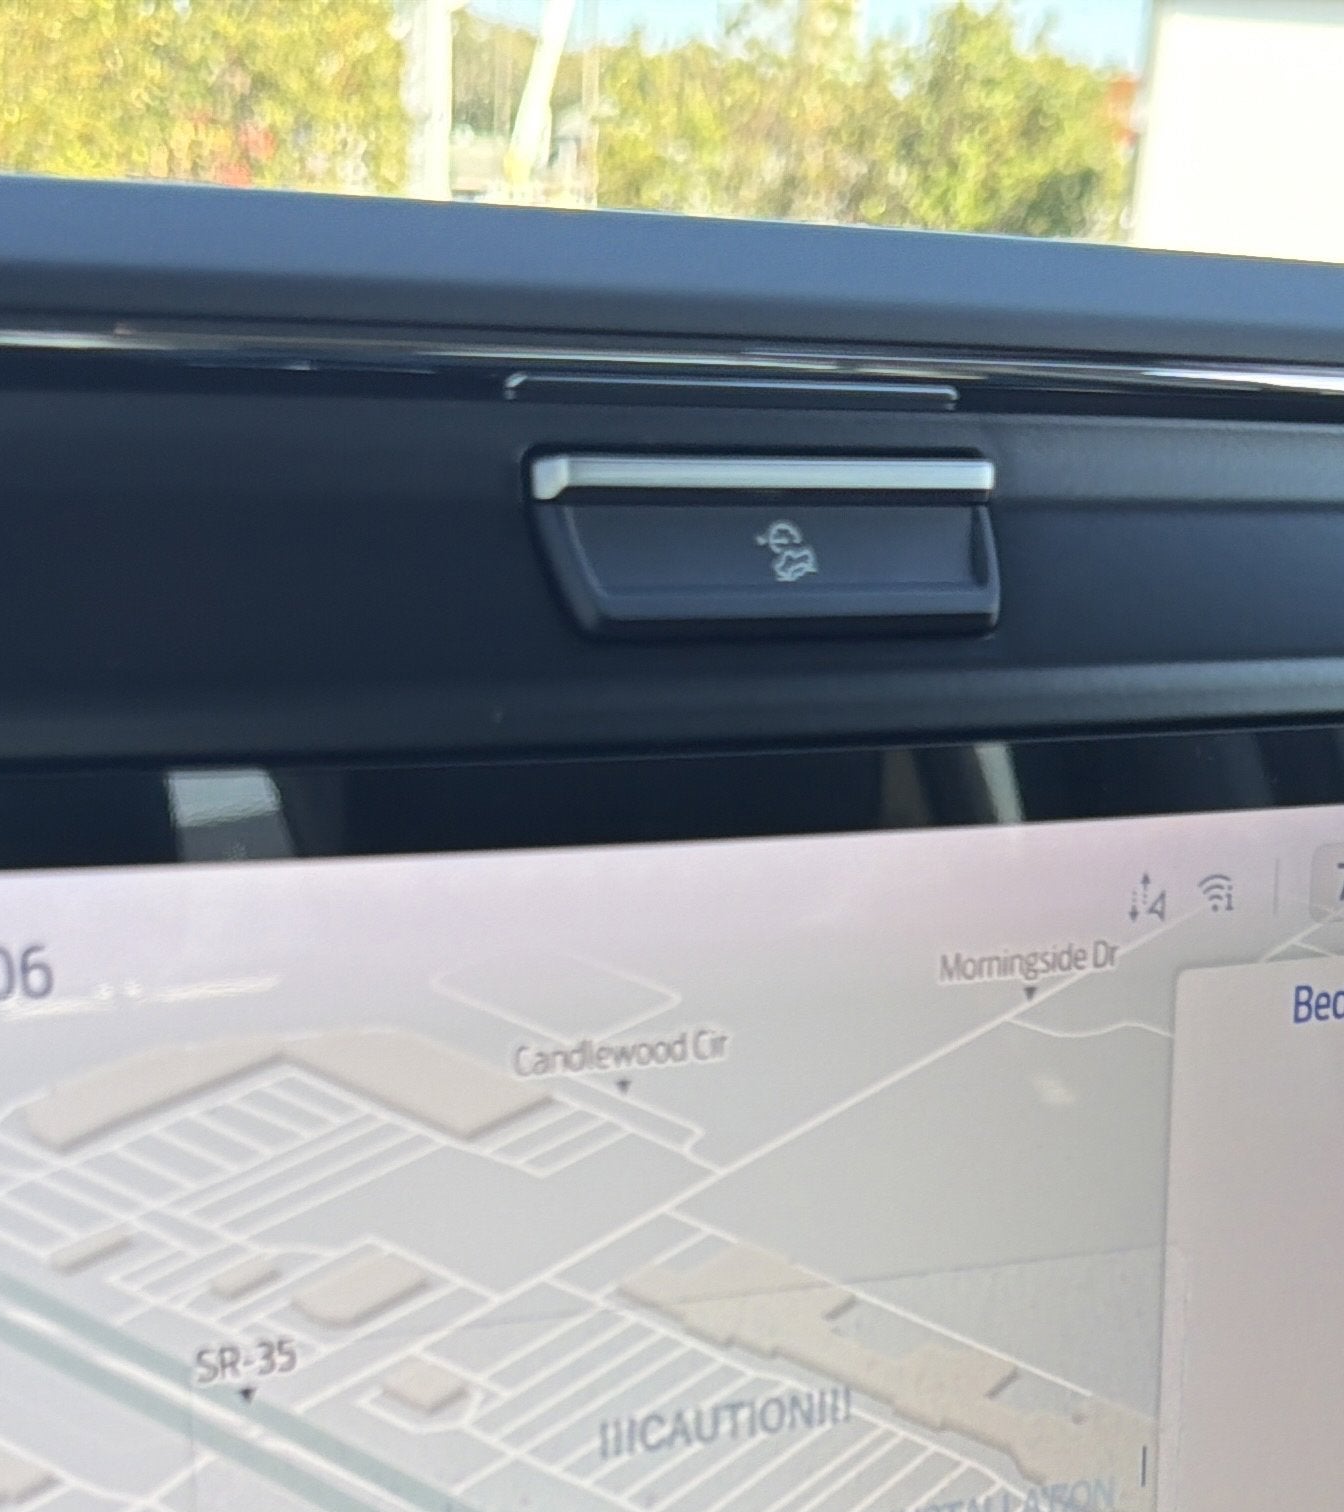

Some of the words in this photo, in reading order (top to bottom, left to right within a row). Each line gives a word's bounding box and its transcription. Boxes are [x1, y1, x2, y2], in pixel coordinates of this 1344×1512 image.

[939, 948, 1087, 984] Morningside
[1091, 940, 1119, 970] Dr
[513, 1038, 687, 1078] Candlewood
[692, 1028, 728, 1061] Cir
[194, 1340, 299, 1382] SR-35
